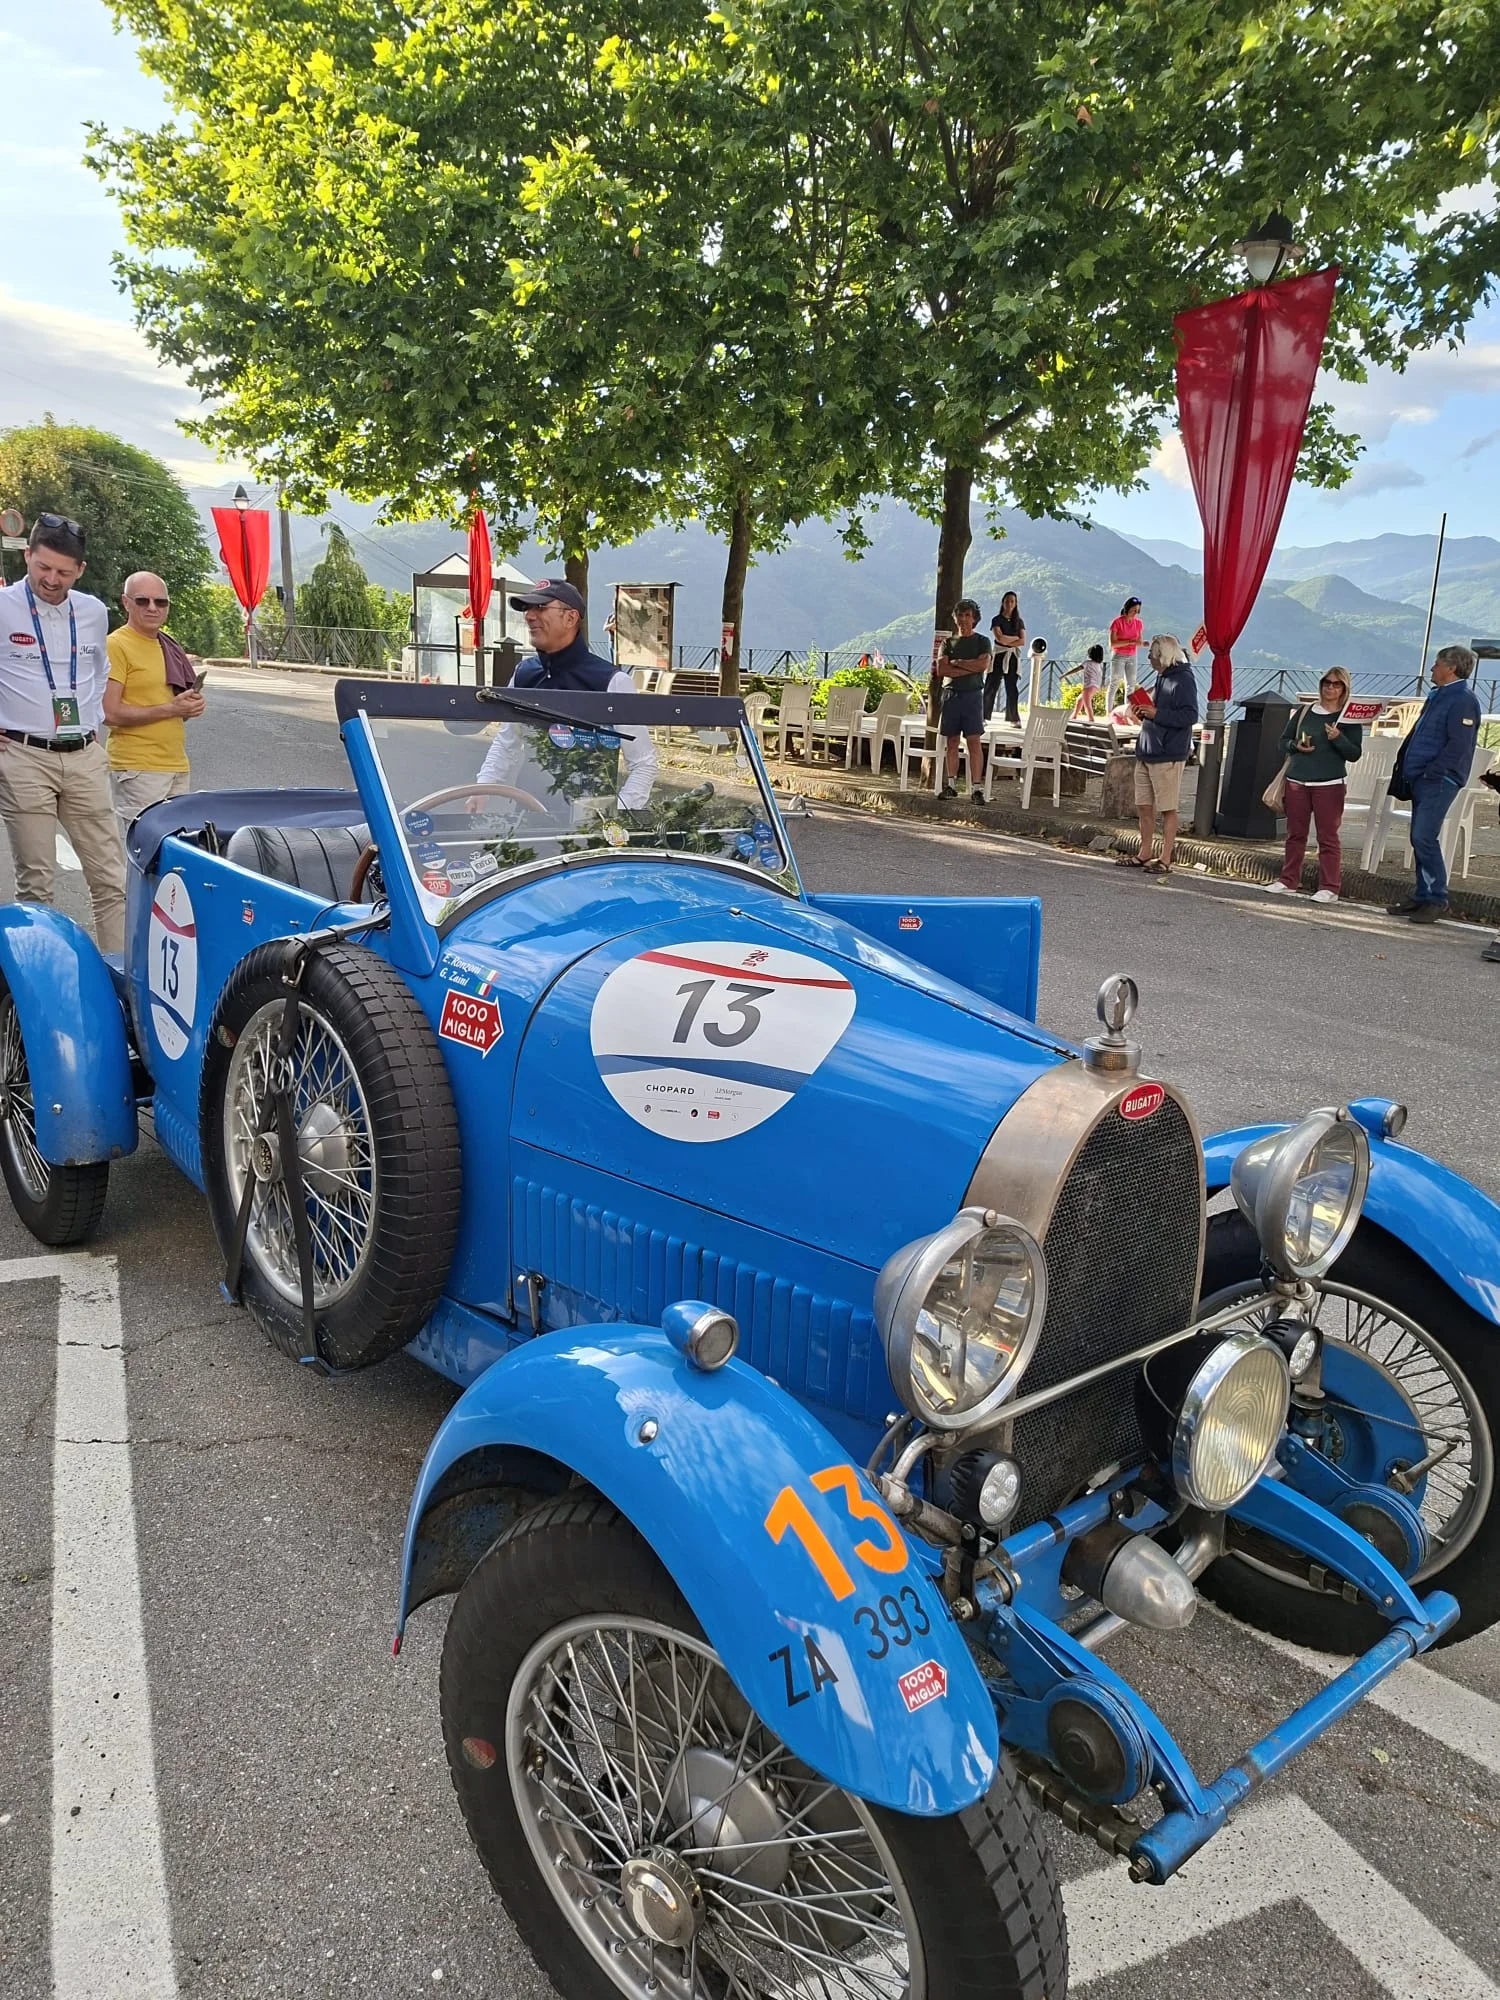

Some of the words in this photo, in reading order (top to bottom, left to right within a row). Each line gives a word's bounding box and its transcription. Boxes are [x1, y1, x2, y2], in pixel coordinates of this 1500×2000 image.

[427, 880, 447, 890] 2015
[161, 936, 179, 1000] 13
[440, 967, 448, 979] G.
[452, 998, 488, 1022] 1000
[672, 980, 776, 1048] 13
[444, 1018, 486, 1045] MIGLIA
[646, 1084, 695, 1095] CHOPARD
[1125, 1093, 1161, 1113] BUGATTI
[764, 1464, 908, 1601] 13
[768, 1635, 839, 1707] ZA
[853, 1586, 931, 1660] 393
[904, 1666, 934, 1691] 1000
[908, 1680, 943, 1708] MIGLIA
